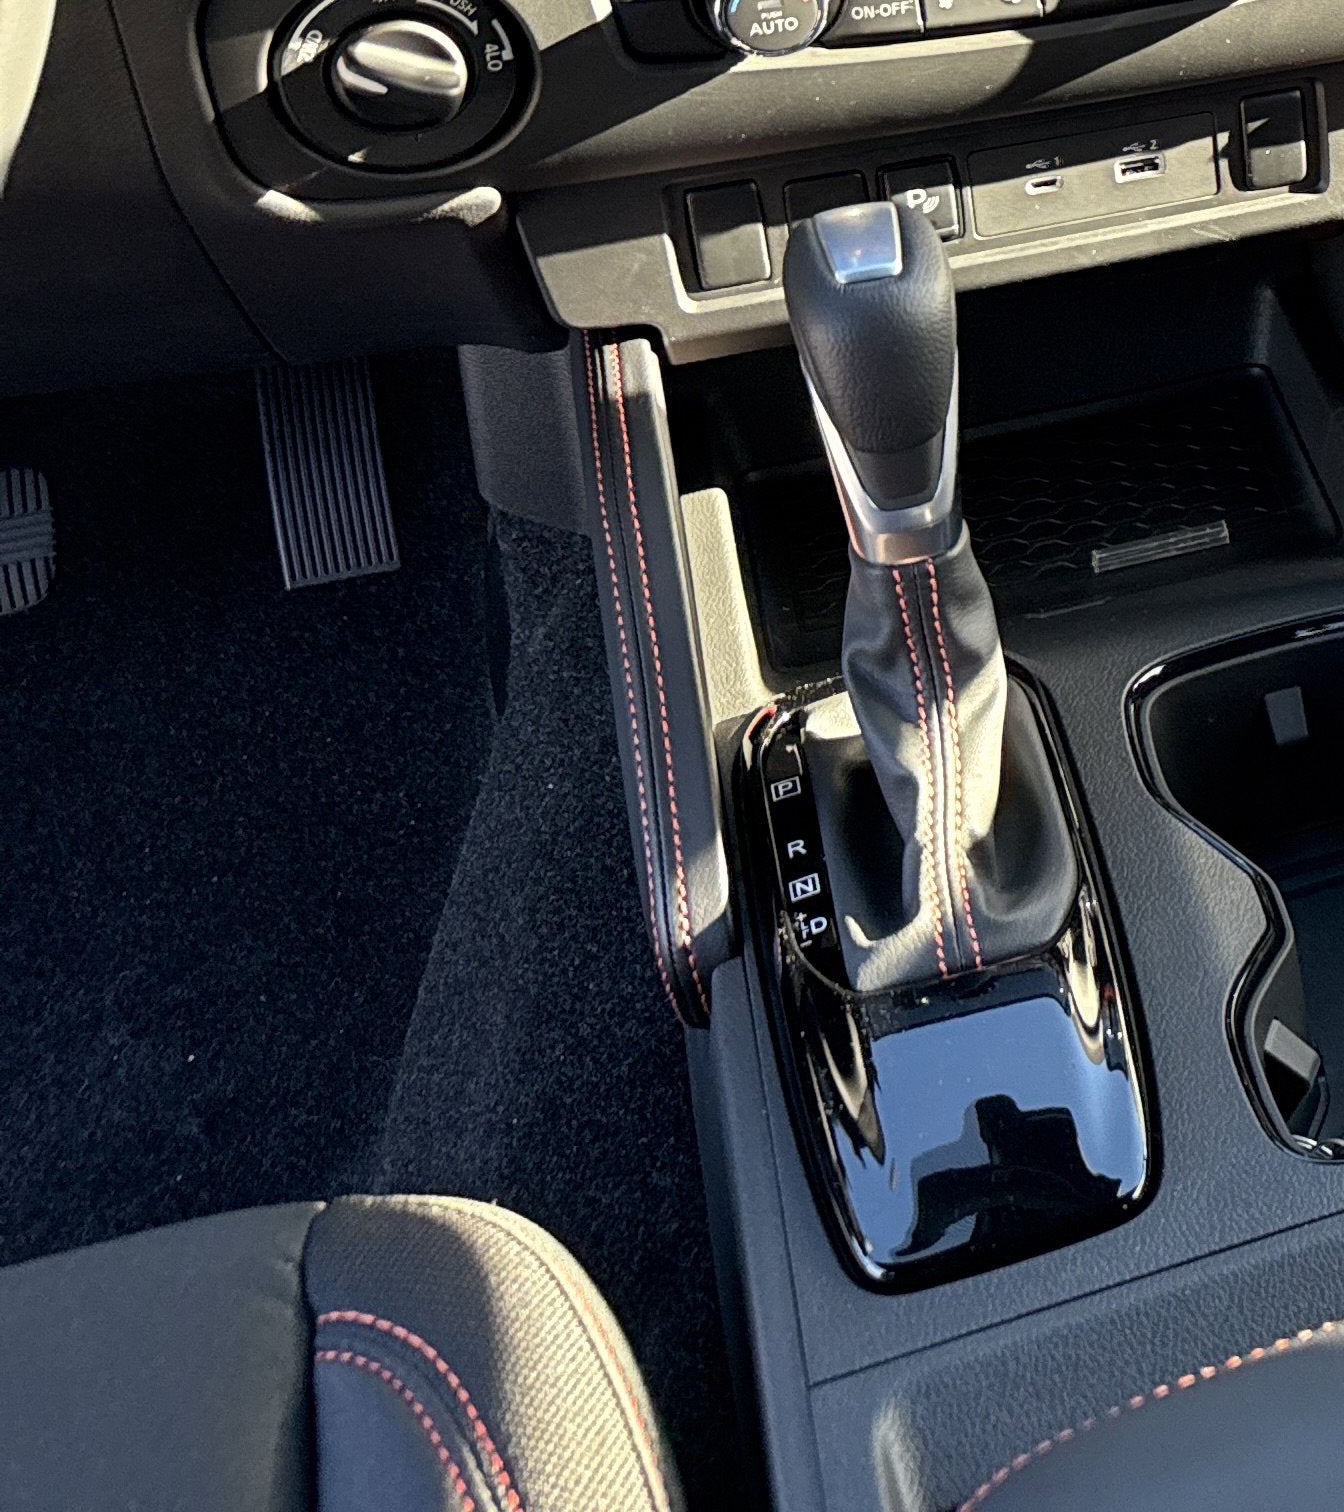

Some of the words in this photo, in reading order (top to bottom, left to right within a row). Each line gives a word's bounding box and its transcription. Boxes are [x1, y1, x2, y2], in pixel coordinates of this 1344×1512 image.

[749, 17, 799, 37] AUTO
[296, 29, 324, 63] 2WD
[485, 43, 504, 72] 4LO
[787, 840, 807, 859] R
[810, 916, 828, 935] D
